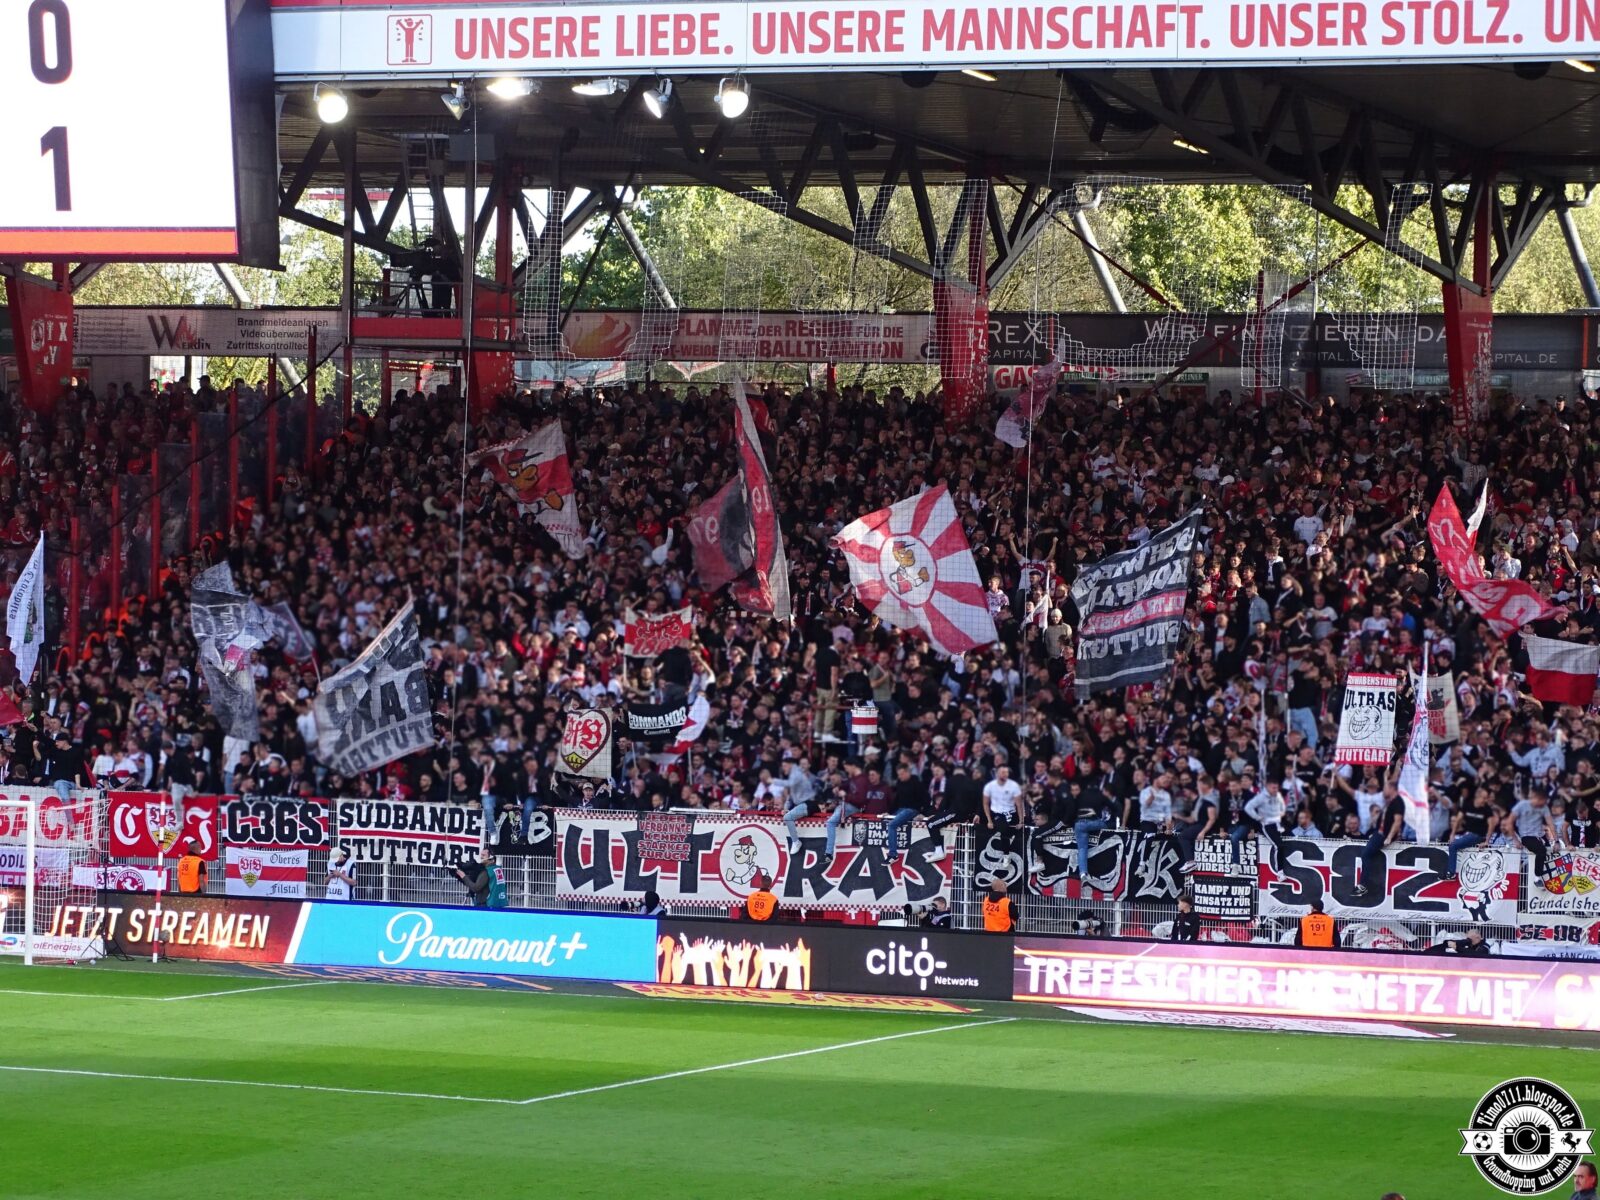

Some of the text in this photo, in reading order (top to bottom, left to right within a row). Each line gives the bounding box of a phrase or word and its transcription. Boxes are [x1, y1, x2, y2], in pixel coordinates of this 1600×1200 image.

[454, 15, 601, 61] UNSERE
[615, 11, 734, 58] LIEBE.
[752, 7, 904, 54] UNSERE
[922, 4, 1210, 52] MANNSCHAFT.
[1228, 4, 1373, 49] UNSER
[1380, 0, 1525, 47] STOLZ.
[28, 0, 73, 84] 0
[39, 126, 72, 211] 1
[855, 324, 879, 337] FÜR
[883, 325, 903, 338] DIE
[1344, 688, 1396, 712] ULTRAS
[628, 706, 687, 729] COMMANDO
[1335, 748, 1392, 763] STUTTGART
[227, 799, 324, 846] C36S
[339, 801, 483, 836] SÜDBANDE
[270, 853, 301, 865] Oberes
[339, 838, 481, 868] STUTTGART
[266, 883, 300, 896] Filstal
[1195, 884, 1251, 896] KAMPF UND
[753, 900, 766, 910] 89
[985, 903, 1000, 913] 224
[1195, 895, 1251, 907] EINSATZ FÜR
[1195, 906, 1220, 915] UNSERE
[44, 905, 123, 940] JETZT
[126, 908, 271, 950] STREAMEN
[1309, 923, 1326, 932] 191
[378, 911, 588, 967] Paramount+
[934, 976, 980, 987] Networks
[1350, 972, 1446, 1013] NETZ
